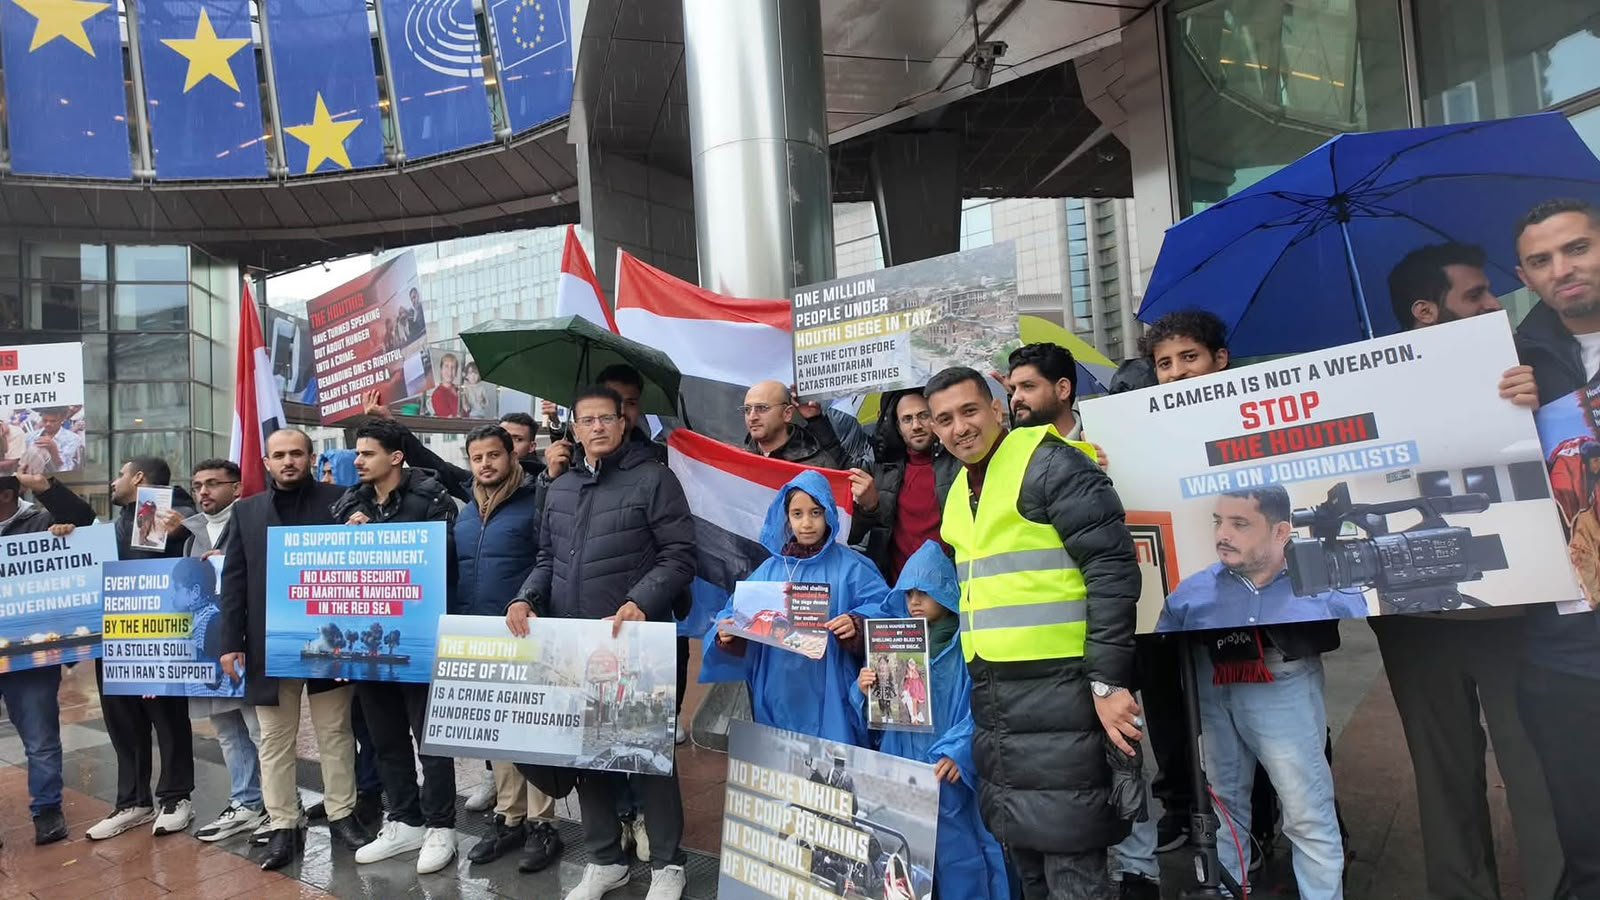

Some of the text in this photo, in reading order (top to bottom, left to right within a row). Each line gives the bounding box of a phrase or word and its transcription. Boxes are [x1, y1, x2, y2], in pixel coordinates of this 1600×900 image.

[795, 279, 875, 308] ONE MILLION
[796, 297, 888, 328] PEOPLE UNDER
[796, 309, 936, 348] HOUTHI SIEGE IN TAIZ.
[798, 340, 895, 366] SAVE THE CITY BEFORE
[376, 372, 383, 383] AS
[798, 358, 872, 378] A HUMANITARIAN
[4, 371, 66, 386] YEMEN'S
[799, 367, 899, 391] CATASTROPHE STRIKES
[1149, 344, 1422, 412] A CAMERA IS NOT A WEAPON.
[14, 391, 56, 404] DEATH
[1240, 391, 1319, 429] STOP
[1216, 417, 1367, 463] THE HOUTHI
[1184, 472, 1230, 495] WAR
[1236, 468, 1264, 488] ON
[1269, 444, 1411, 482] JOURNALISTS
[7, 537, 70, 556] GLOBAL
[285, 529, 428, 546] NO SUPPORT FOR YEMEN'S
[284, 551, 345, 566] LEGITIMATE
[18, 574, 86, 596] YEMEN'S
[105, 575, 169, 591] EVERY CHILD
[304, 570, 406, 583] NO LASTING SECURITY
[292, 586, 419, 598] FOR MARITIME NAVIGATION
[105, 596, 161, 611] RECRUITED
[319, 602, 391, 614] IN THE RED SEA
[105, 619, 189, 633] BY THE HOUTHIS
[105, 644, 113, 656] IS
[117, 644, 122, 656] A
[125, 643, 160, 656] STOLEN
[442, 639, 517, 657] THE HOUTHI
[105, 665, 213, 679] WITH IRAN'S SUPPORT
[438, 661, 528, 681] SIEGE OF TAIZ
[434, 687, 546, 705] IS A CRIME AGAINST
[432, 705, 580, 728] HUNDREDS OF THOUSANDS
[429, 725, 499, 742] OF CIVILIANS
[730, 759, 848, 817] NO PEACE WHILE
[727, 791, 869, 863] THE COUP REMAINS
[725, 818, 806, 870] IN CONTROL
[722, 852, 739, 875] OF
[743, 858, 806, 900] YEMEN'S
